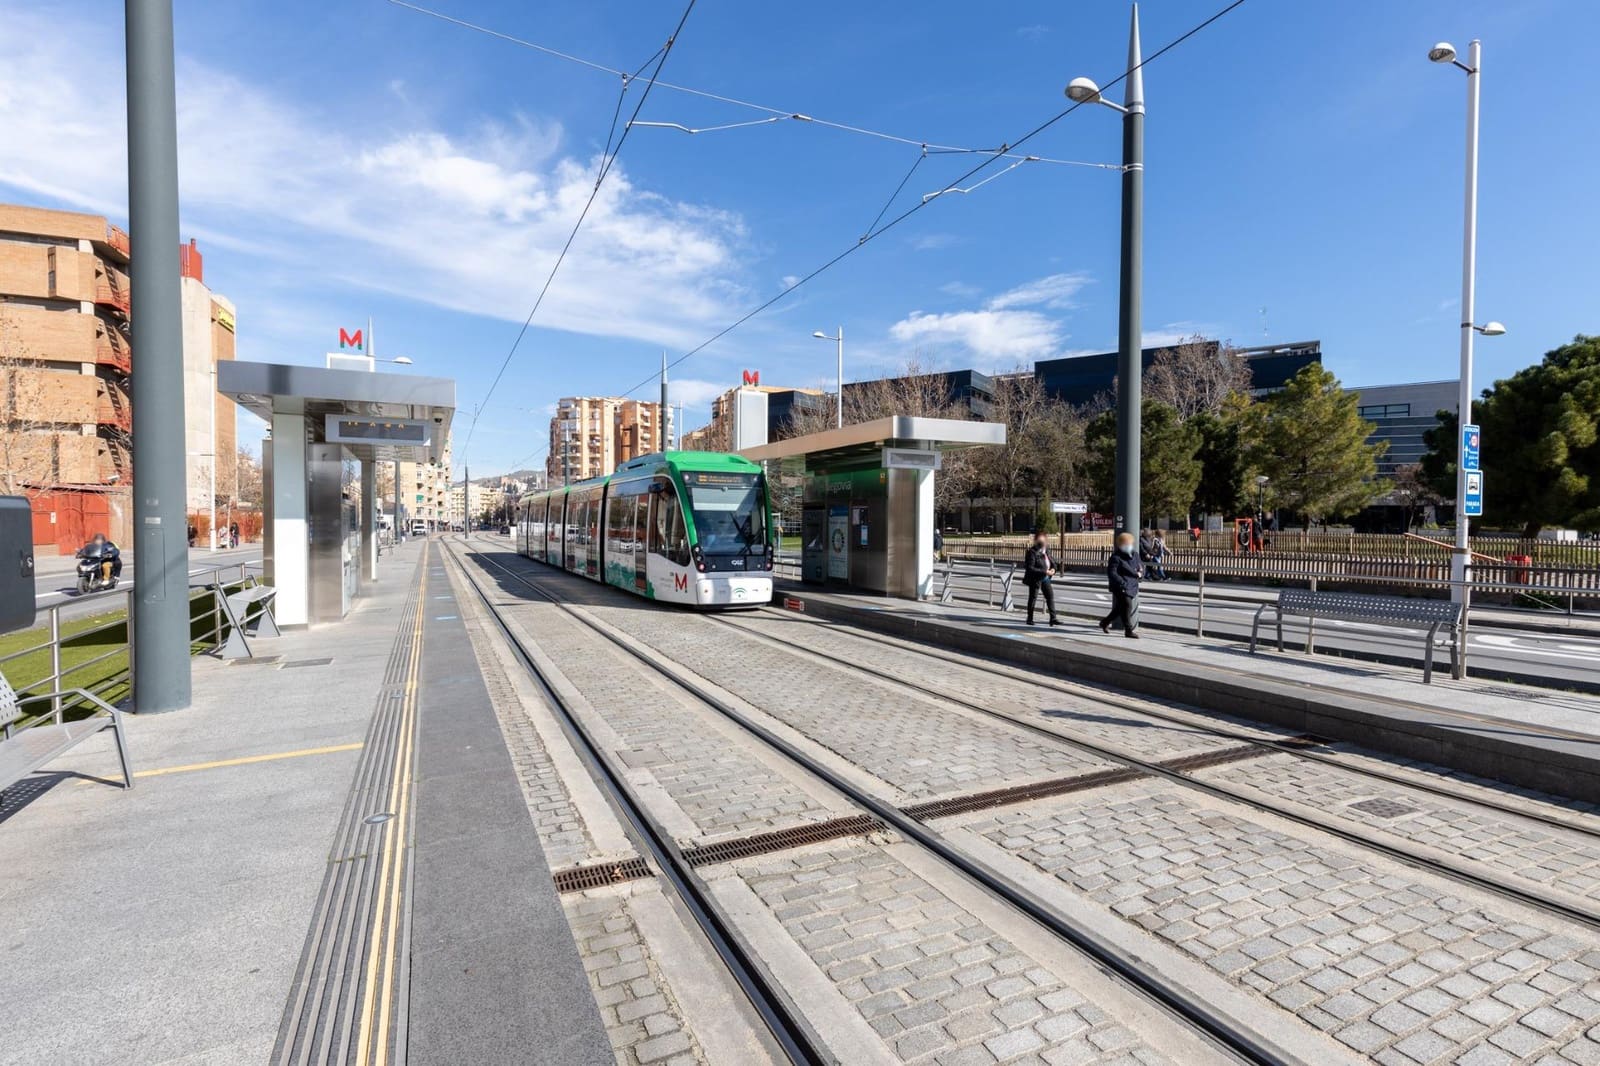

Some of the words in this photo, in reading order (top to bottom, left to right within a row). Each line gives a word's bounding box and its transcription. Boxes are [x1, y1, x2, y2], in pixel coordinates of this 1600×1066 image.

[340, 328, 362, 350] M
[743, 369, 759, 387] M
[675, 572, 688, 593] M
